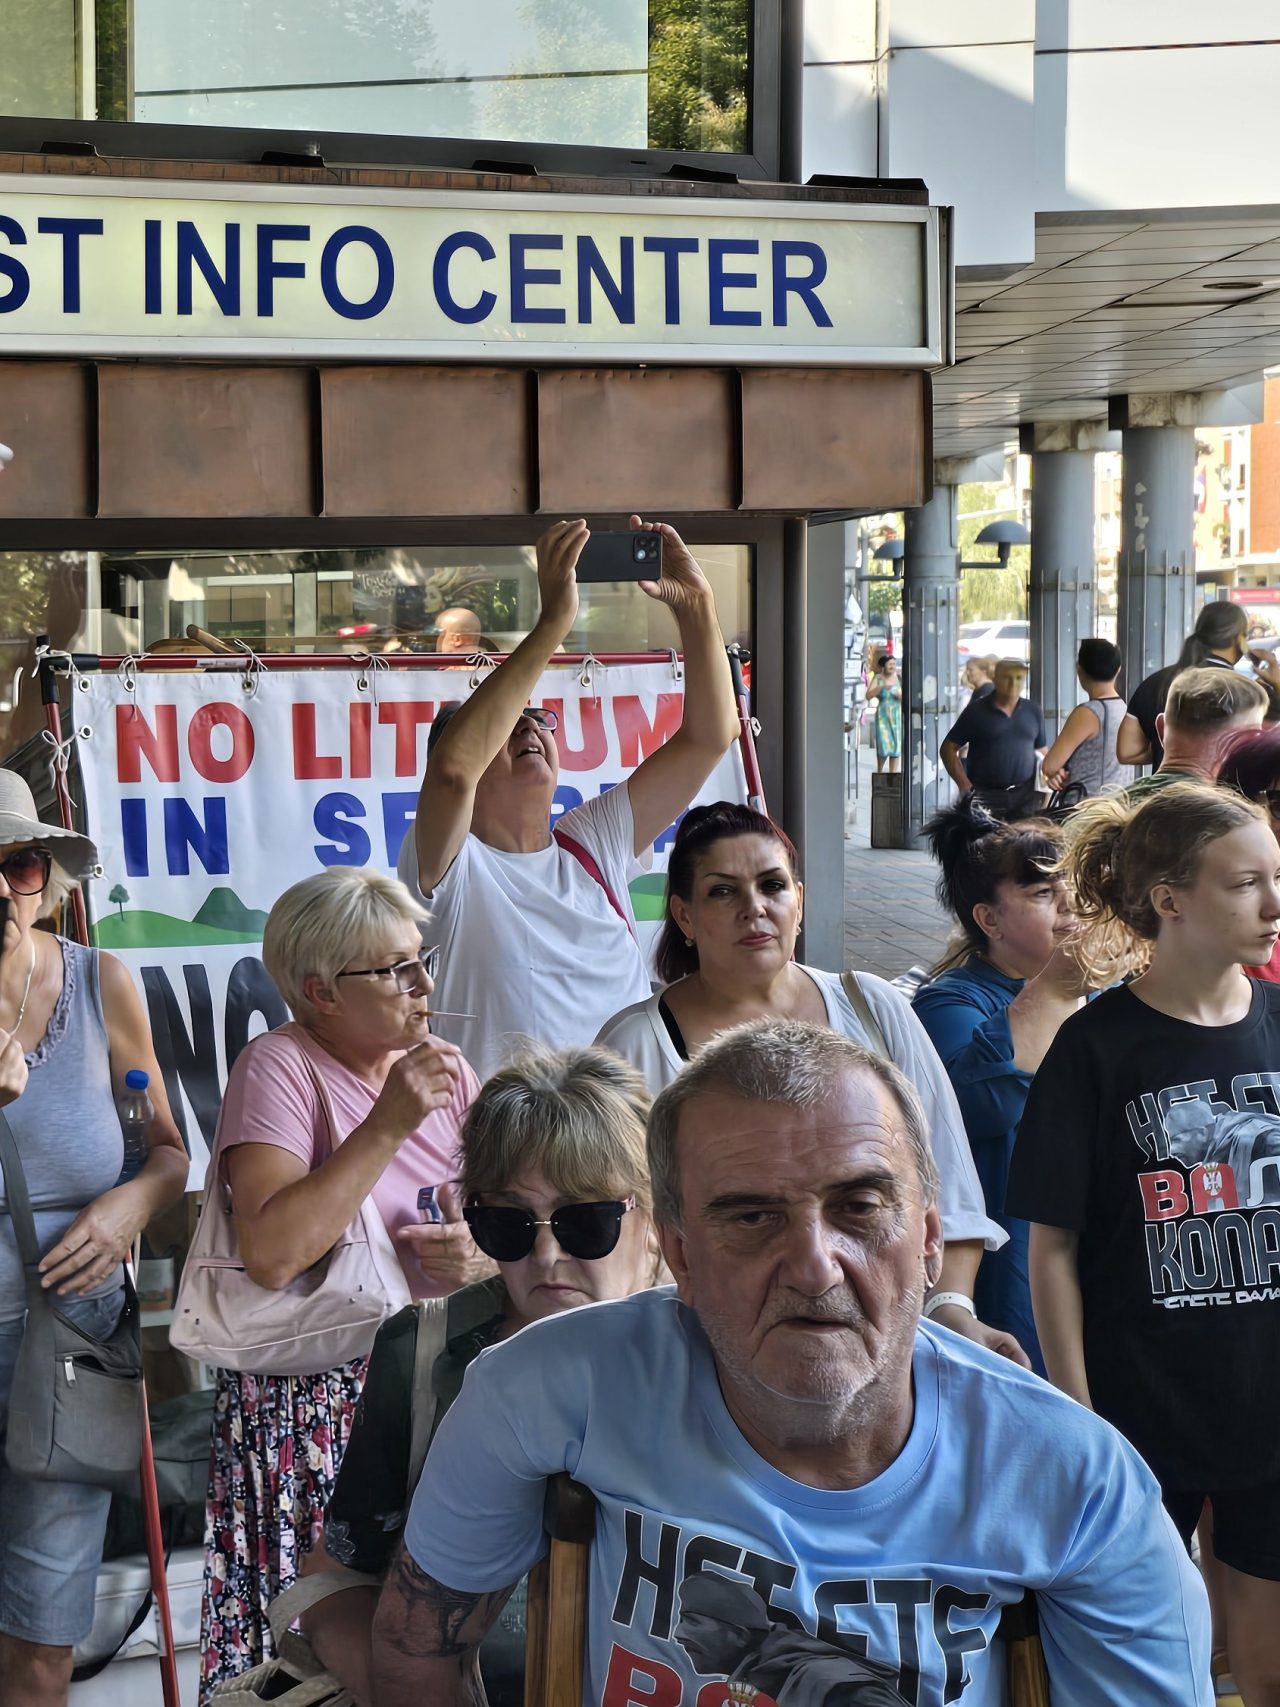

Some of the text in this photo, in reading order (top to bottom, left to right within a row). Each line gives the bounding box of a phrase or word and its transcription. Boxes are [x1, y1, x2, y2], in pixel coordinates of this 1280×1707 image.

[144, 219, 395, 320] INFO
[432, 231, 834, 328] CENTER
[115, 692, 684, 783] NO LITUM
[120, 796, 230, 877] IN
